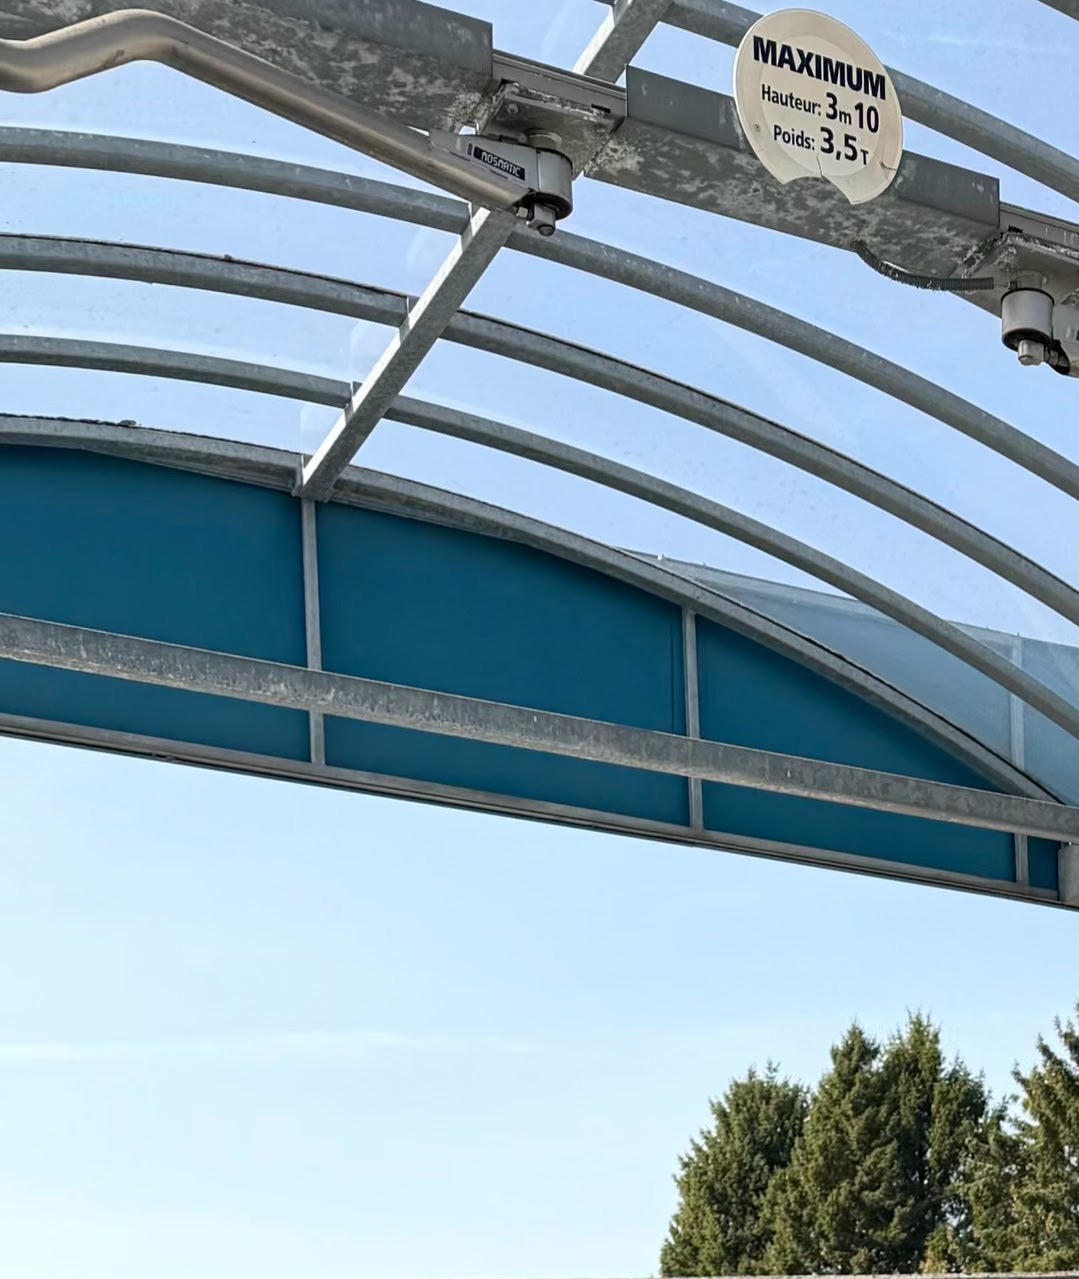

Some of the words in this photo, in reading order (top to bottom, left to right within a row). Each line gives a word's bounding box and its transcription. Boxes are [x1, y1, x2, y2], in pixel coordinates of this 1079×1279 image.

[753, 36, 886, 100] MAXIMUM
[761, 84, 822, 116] Hauteur:
[774, 125, 815, 151] Poids:
